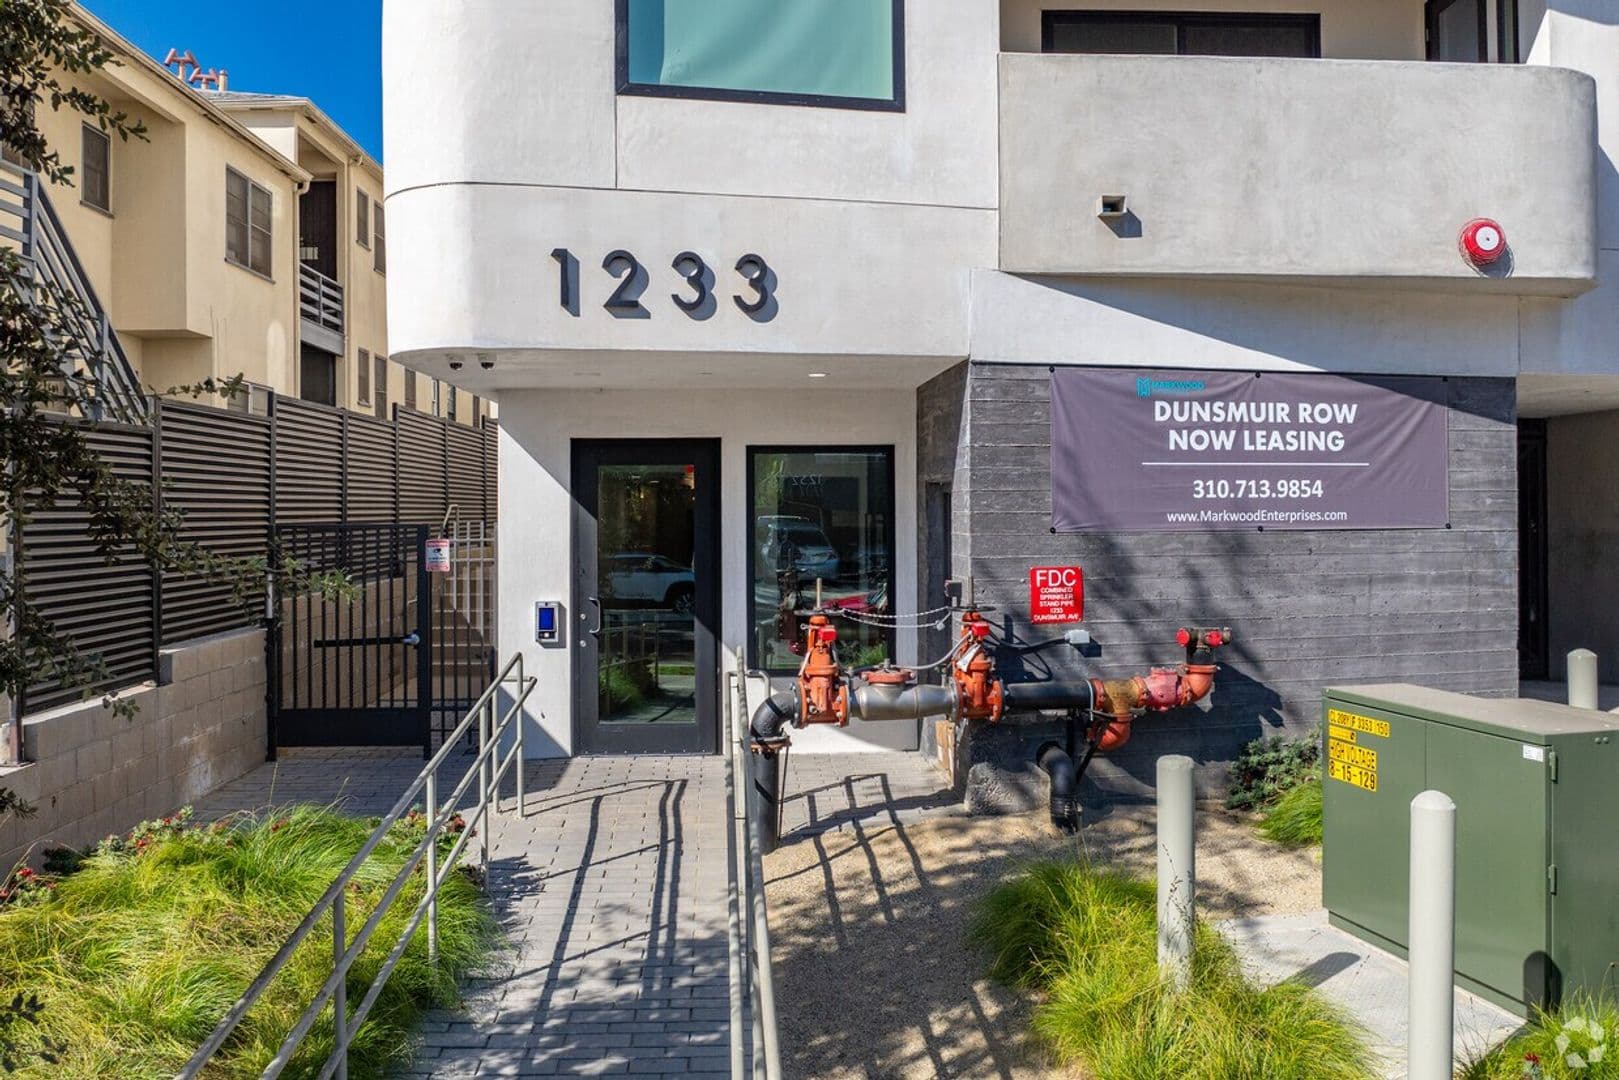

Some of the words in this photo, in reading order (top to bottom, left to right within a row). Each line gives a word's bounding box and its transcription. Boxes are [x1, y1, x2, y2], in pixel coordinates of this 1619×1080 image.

[550, 247, 769, 313] 1233
[1154, 400, 1291, 423] DUNSMUIR
[1298, 402, 1358, 424] ROW
[1168, 429, 1237, 451] NOW
[1243, 430, 1345, 452] LEASING
[1193, 479, 1324, 499] 310.713.9854
[1167, 509, 1348, 523] www.MarkwoodEnterprises.com
[1036, 569, 1076, 588] FDC
[1329, 759, 1375, 790] 8-15-129
